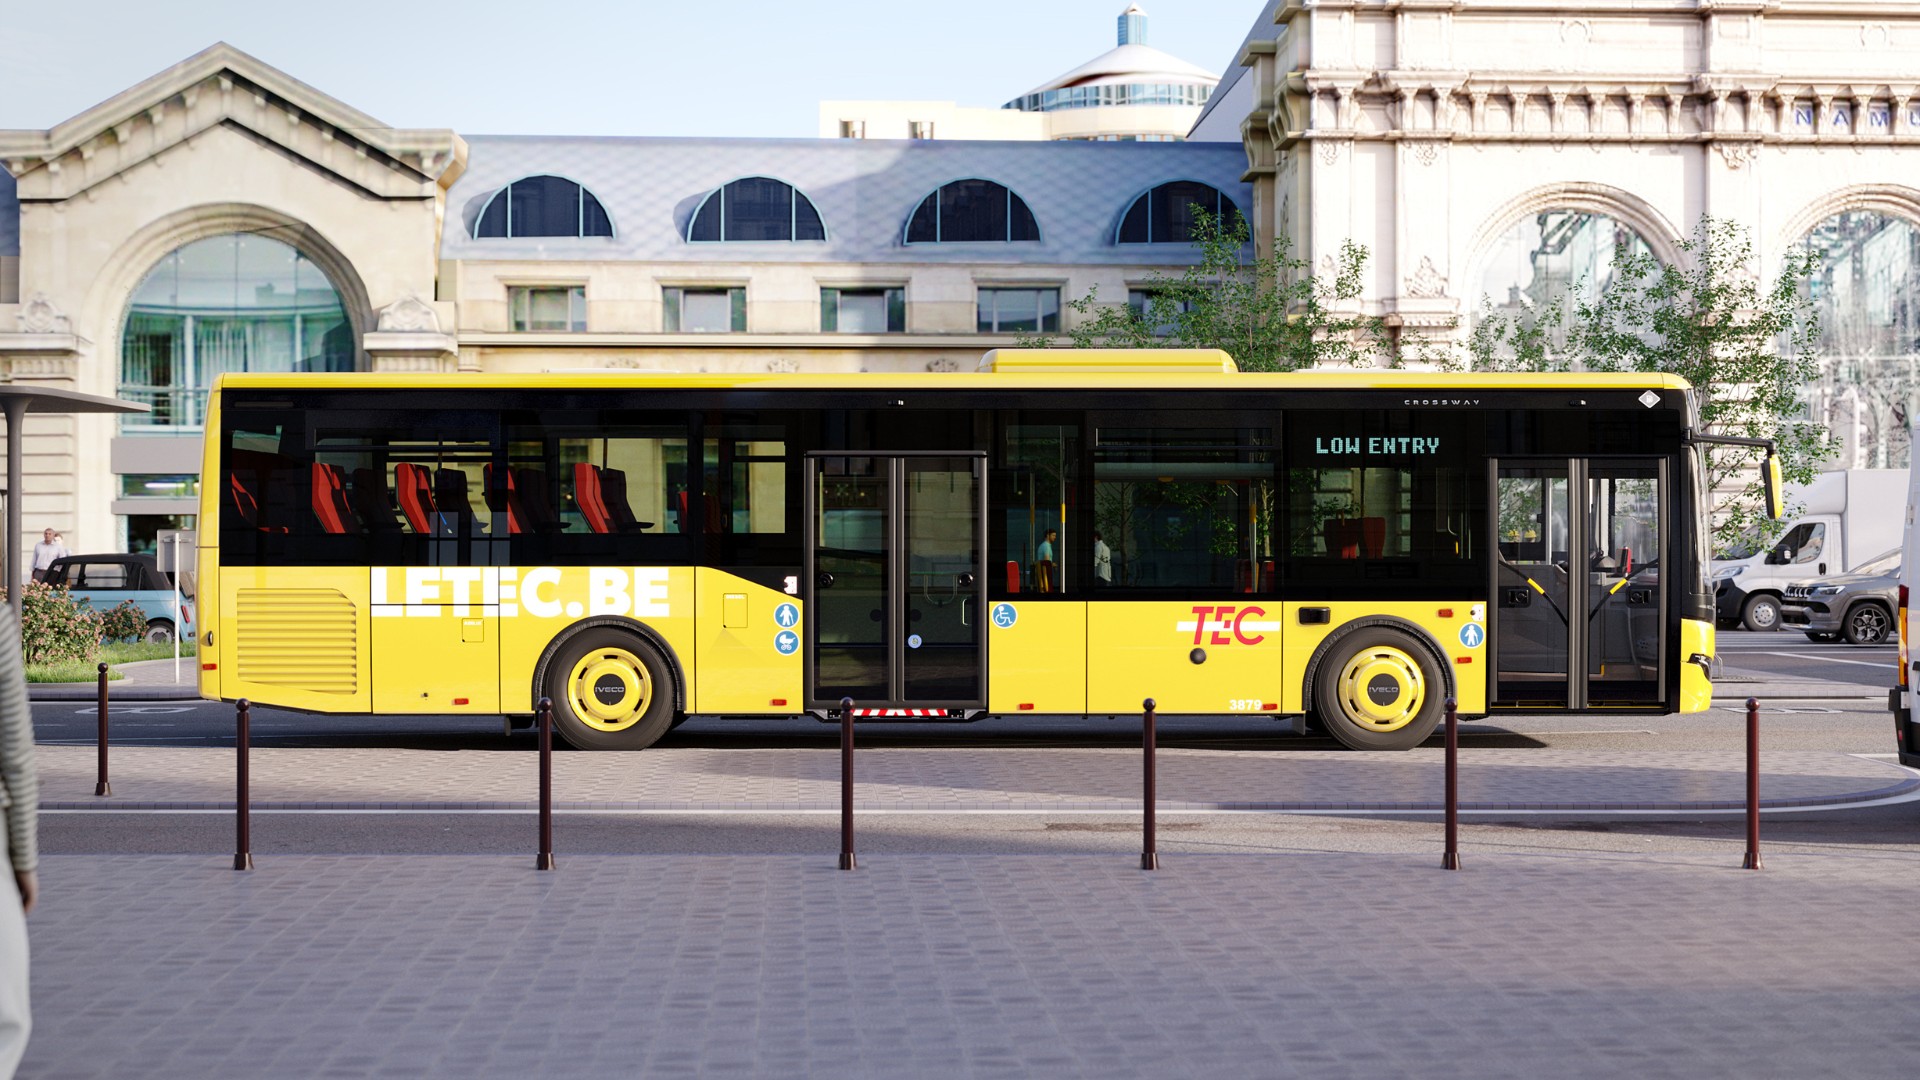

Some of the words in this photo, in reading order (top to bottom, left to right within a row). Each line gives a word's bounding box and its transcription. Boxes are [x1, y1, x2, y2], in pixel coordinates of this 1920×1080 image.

[1316, 437, 1359, 454] LOW
[1369, 437, 1439, 454] ENTRY
[371, 567, 669, 618] LETEC.BE
[1192, 606, 1266, 646] TEC
[1229, 699, 1263, 711] 3879
